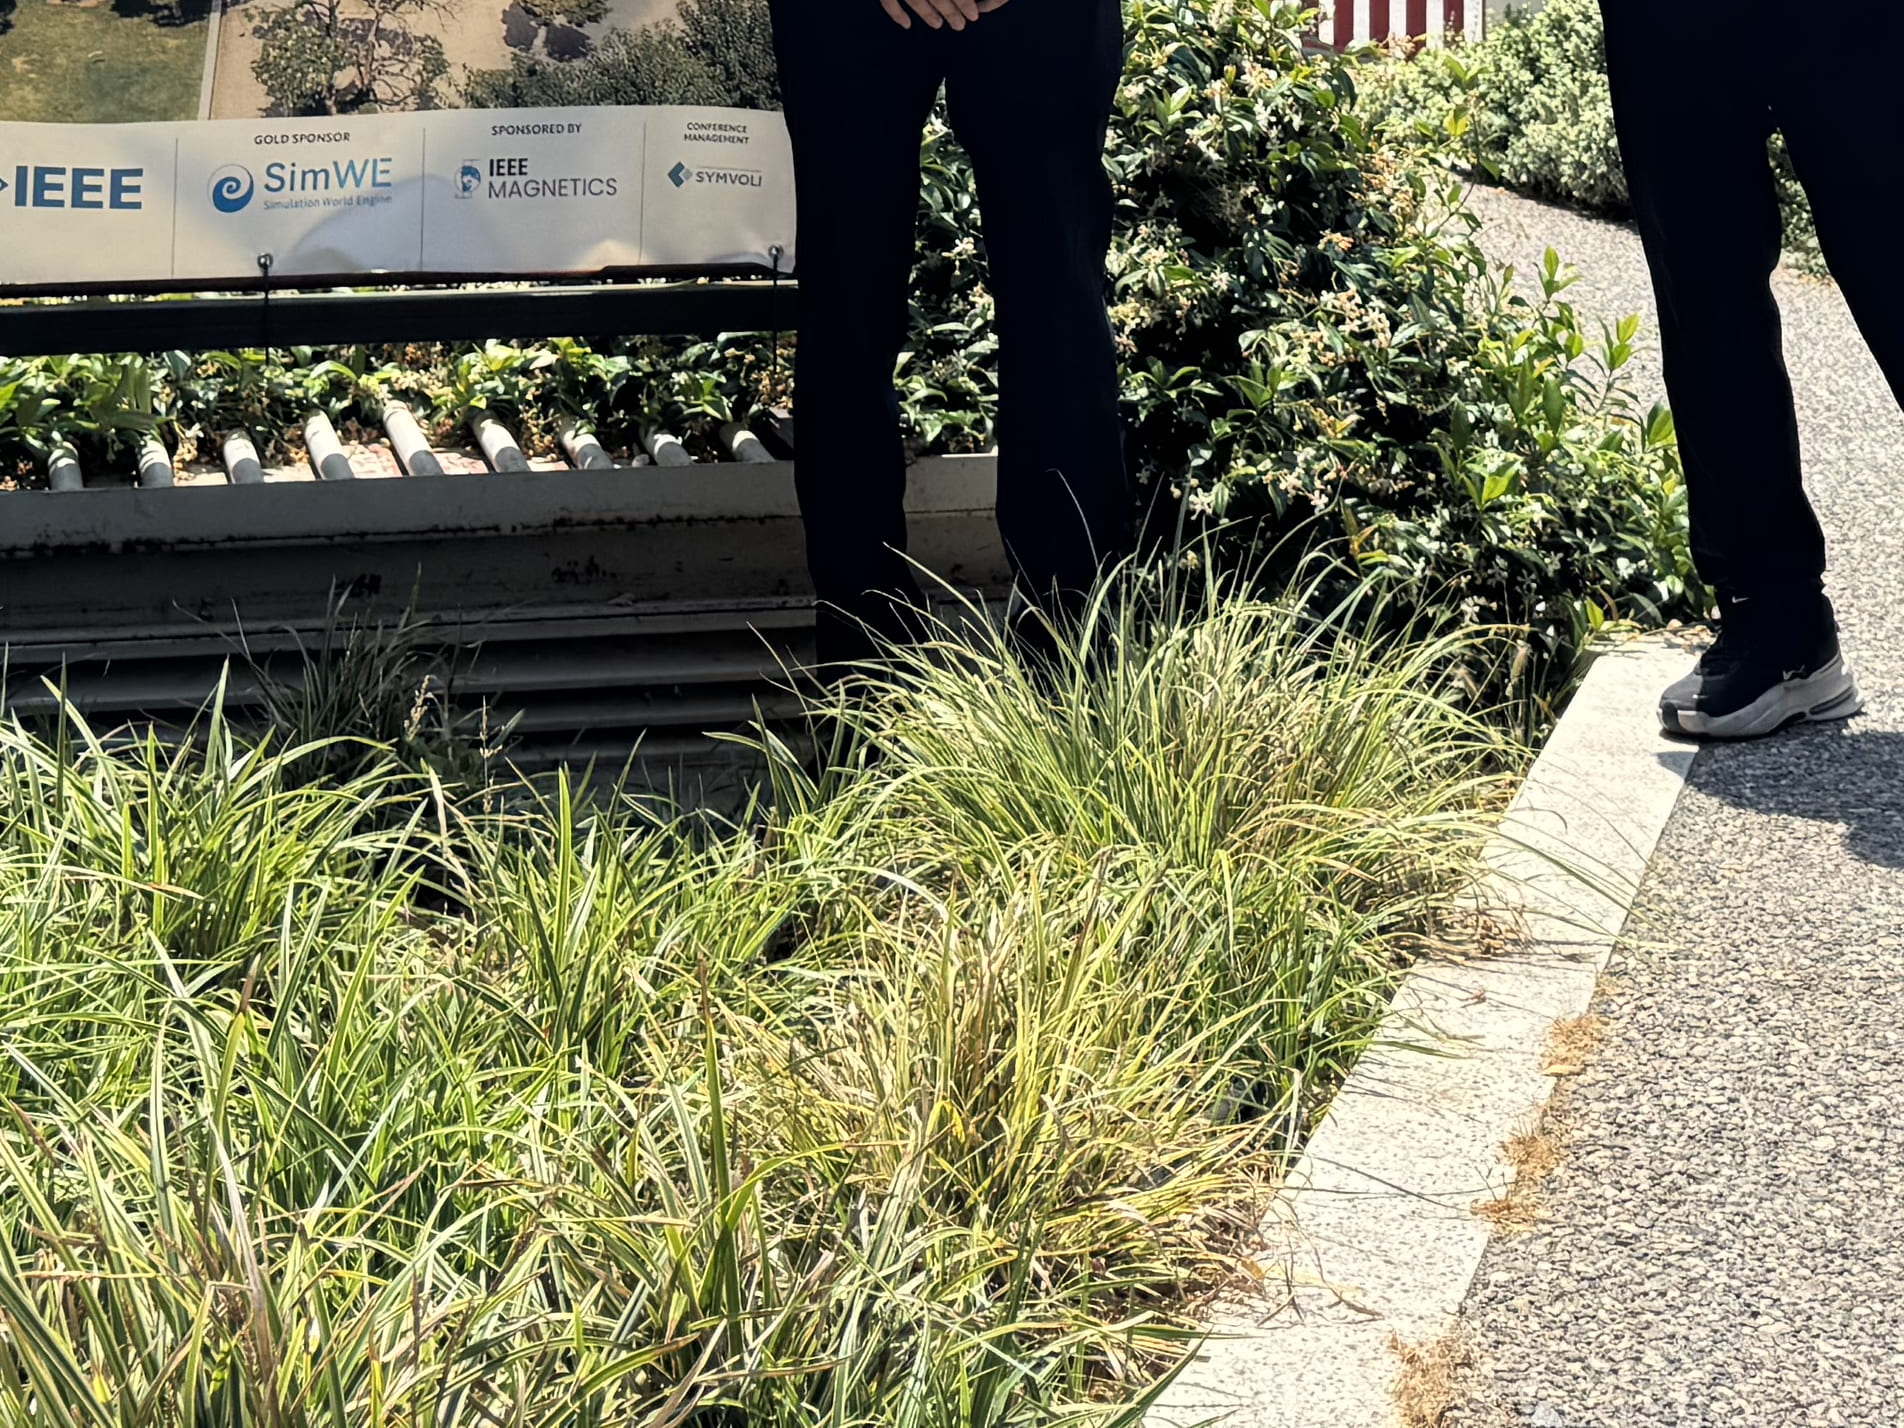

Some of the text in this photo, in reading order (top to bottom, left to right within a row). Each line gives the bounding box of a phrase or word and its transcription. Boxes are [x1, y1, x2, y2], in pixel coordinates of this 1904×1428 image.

[491, 123, 583, 136] SPONSORED BY
[686, 122, 748, 134] CONFERENCE
[254, 132, 351, 145] GOLD SPONSOR
[683, 133, 750, 145] MANAGEMENT
[264, 157, 393, 193] SimWE
[489, 158, 529, 177] IEEE
[14, 164, 144, 210] IEEE
[695, 171, 763, 187] SYMVOLI
[488, 177, 619, 199] MAGNETICS
[263, 194, 393, 211] Simulation World Engine
